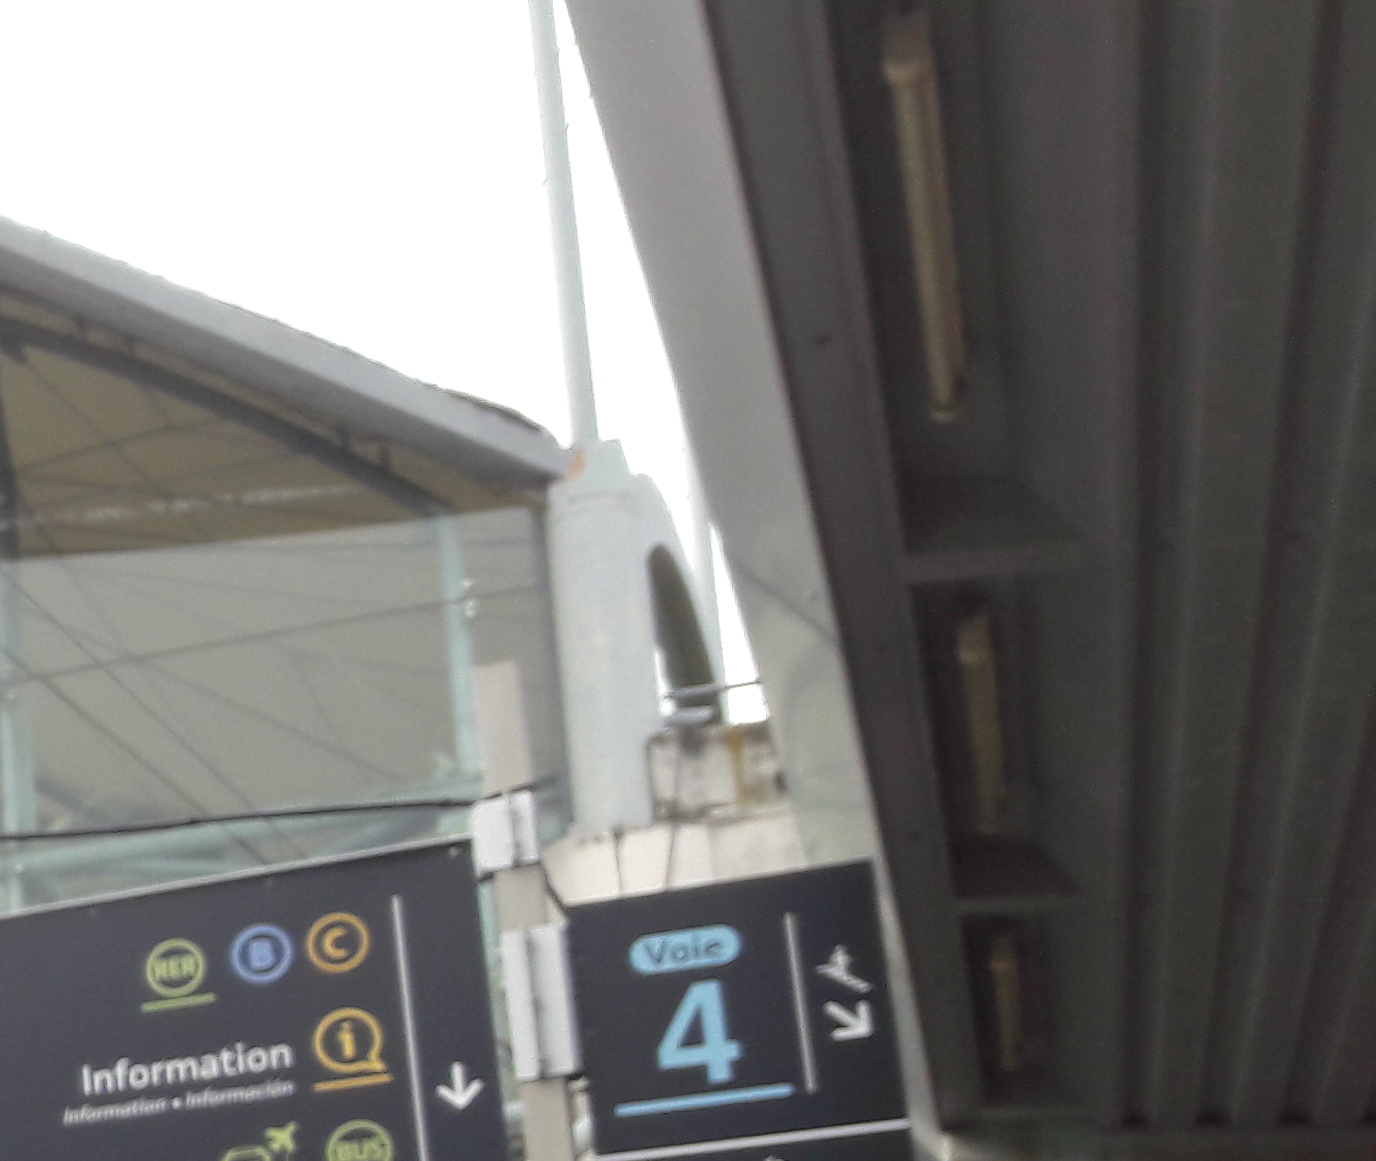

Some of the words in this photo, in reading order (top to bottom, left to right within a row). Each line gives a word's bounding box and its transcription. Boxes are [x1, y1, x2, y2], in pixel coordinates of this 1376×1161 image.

[322, 927, 348, 959] C
[643, 938, 723, 965] Voie
[656, 977, 744, 1084] 4
[81, 1041, 294, 1096] Information
